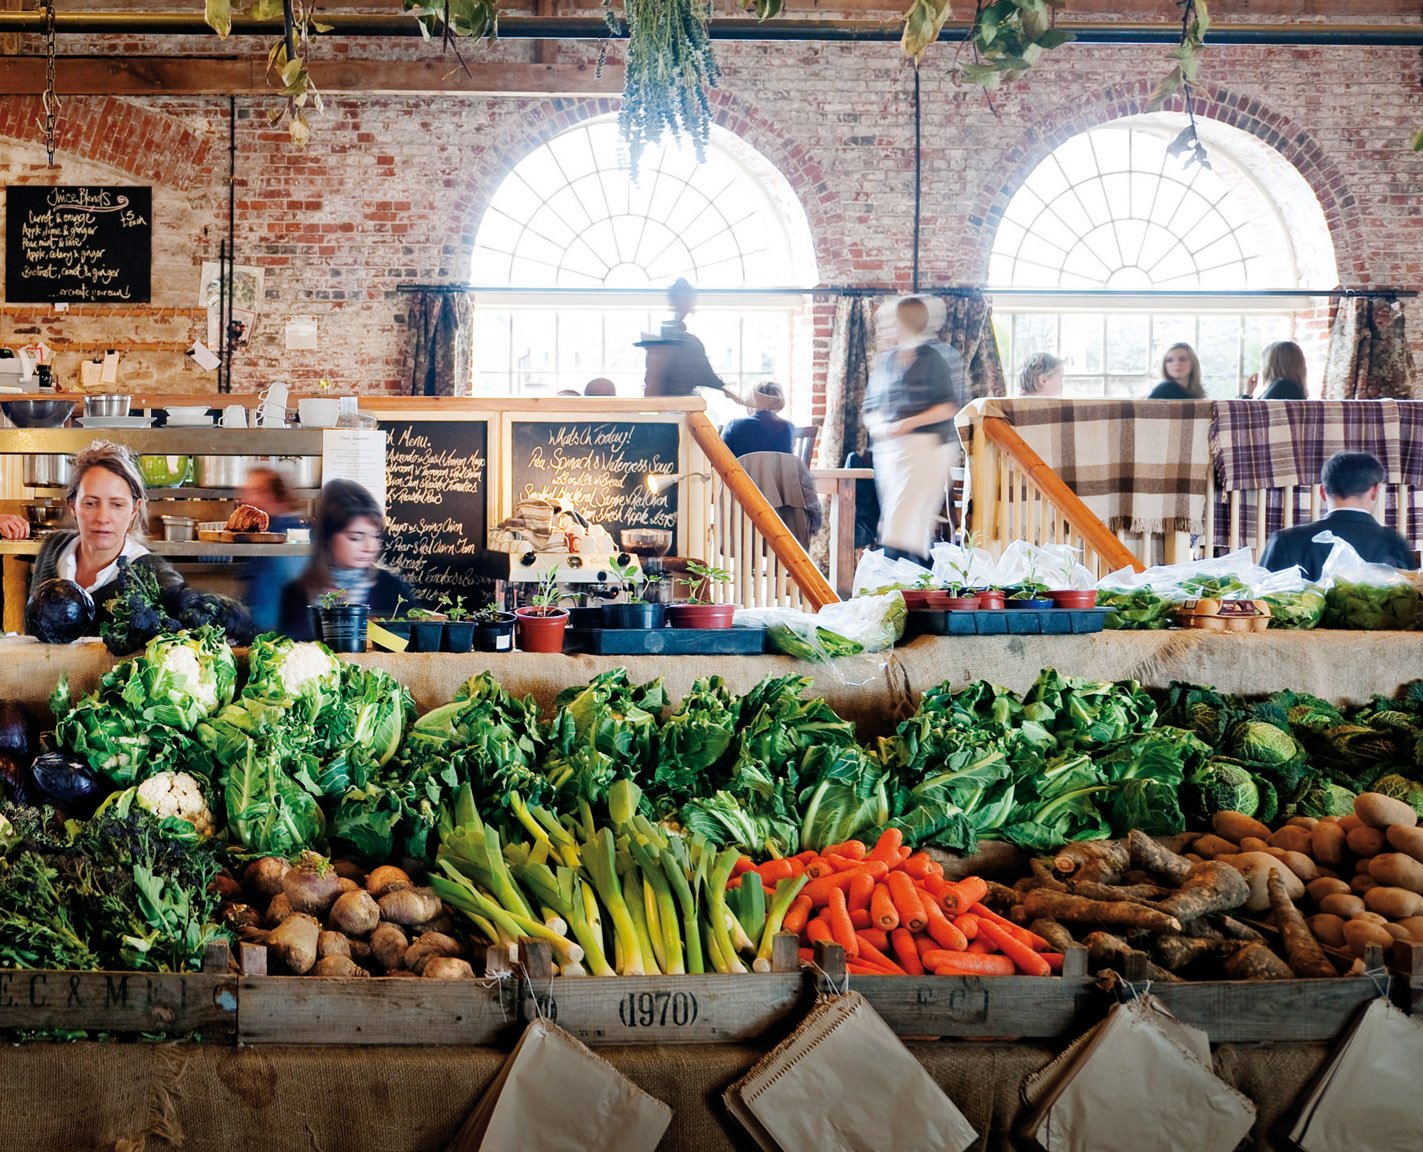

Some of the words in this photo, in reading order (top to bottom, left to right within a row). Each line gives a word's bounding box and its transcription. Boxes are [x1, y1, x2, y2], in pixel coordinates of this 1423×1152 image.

[47, 187, 76, 206] Juice
[76, 188, 111, 206] Blends
[29, 209, 55, 227] Carrot
[56, 213, 62, 223] &
[63, 213, 95, 228] orange
[70, 225, 98, 241] ginger
[80, 246, 106, 263] ginger
[92, 264, 120, 284] ginger
[593, 423, 636, 453] Today!
[549, 447, 595, 475] Spinach
[601, 451, 649, 474] Watercress
[648, 453, 675, 475] Soup
[618, 990, 699, 1028] (1970)
